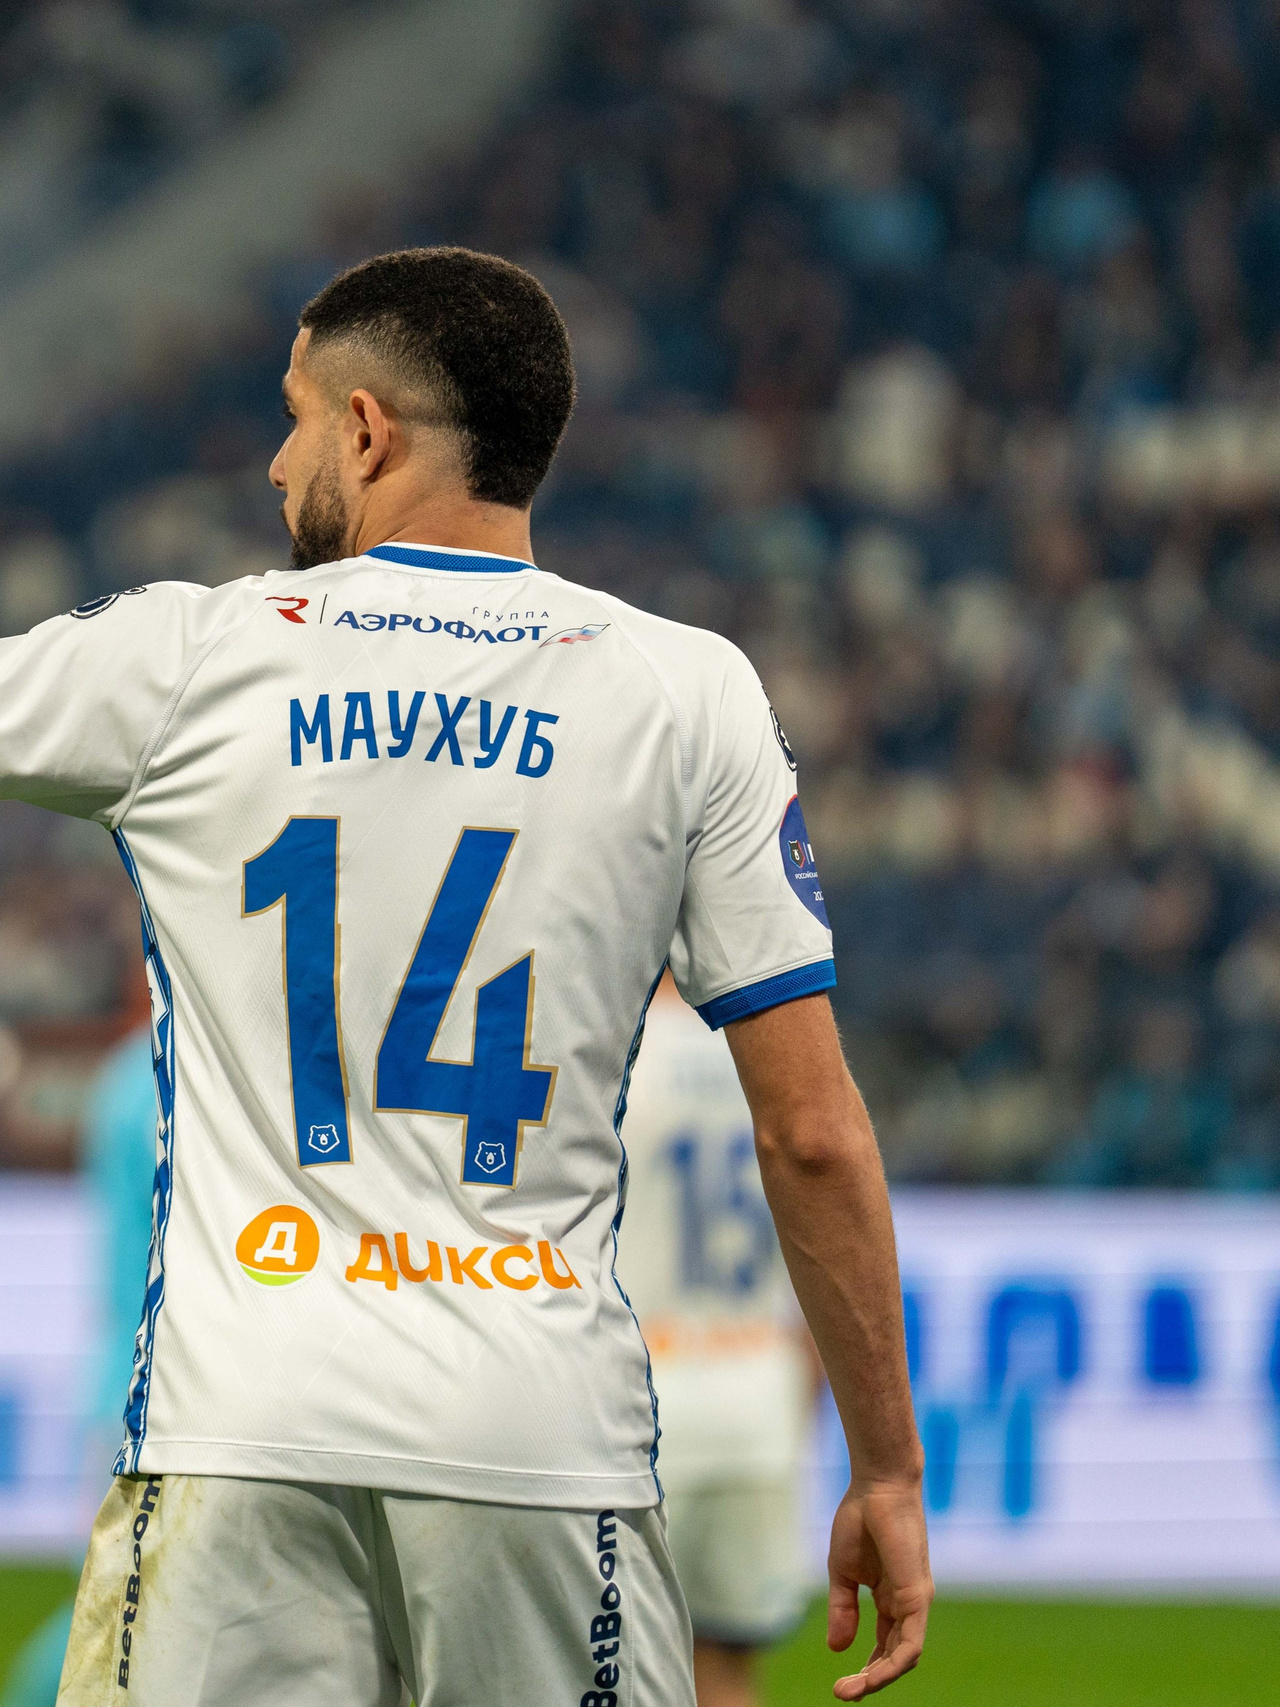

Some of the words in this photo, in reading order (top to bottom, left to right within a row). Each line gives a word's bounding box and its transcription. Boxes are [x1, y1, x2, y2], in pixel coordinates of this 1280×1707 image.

[333, 610, 548, 644] АЭРОФЛОТ
[472, 606, 550, 623] ГРУППА
[289, 690, 560, 778] МАУХУБ
[241, 815, 559, 1189] 14
[118, 1474, 163, 1690] BetBoom
[580, 1509, 622, 1707] BetBoom
